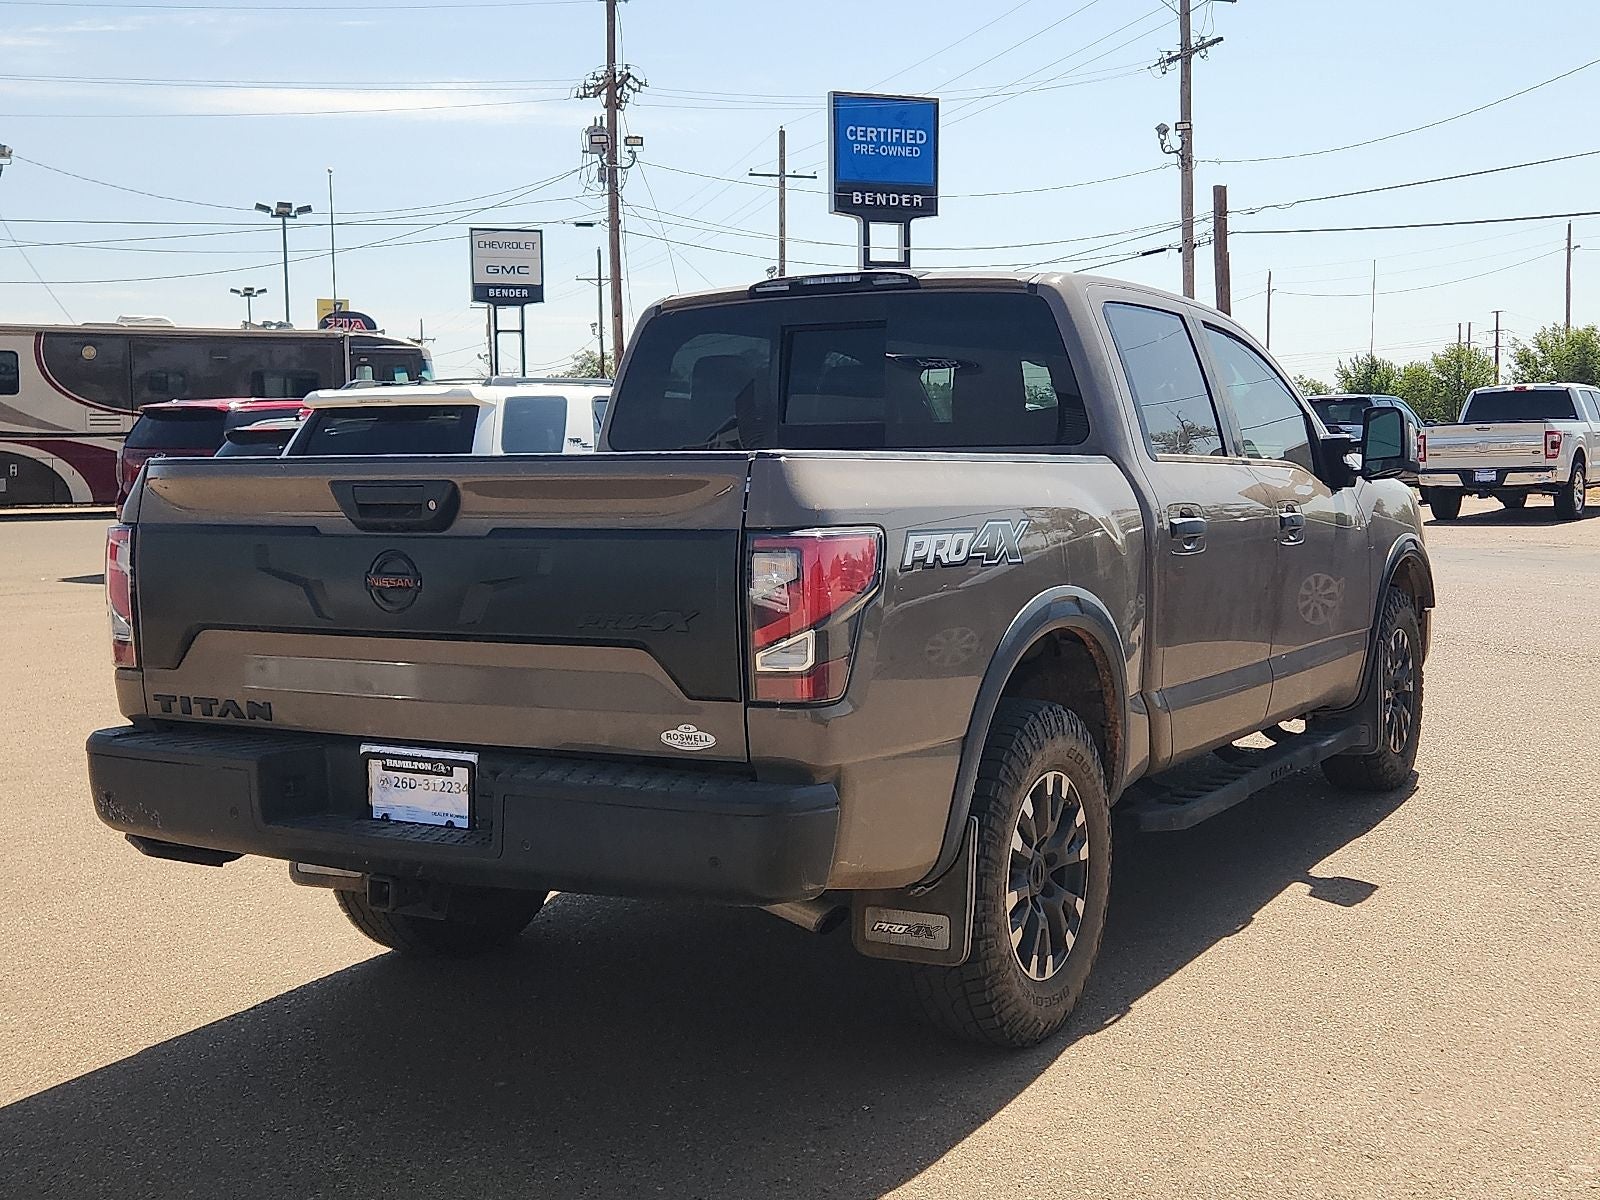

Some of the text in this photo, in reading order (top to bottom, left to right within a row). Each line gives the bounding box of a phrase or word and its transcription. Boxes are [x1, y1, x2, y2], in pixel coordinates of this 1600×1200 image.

[846, 126, 927, 144] CERTIFIED
[853, 144, 921, 157] PRE-OWNED
[852, 192, 923, 207] BENDER
[477, 240, 537, 250] CHEVROLET
[486, 265, 530, 275] GMC
[488, 288, 529, 298] BENDER
[370, 577, 413, 588] NISSAN
[153, 694, 273, 721] TITAN
[665, 732, 711, 743] ROSWELL
[386, 759, 432, 771] HAMILTON
